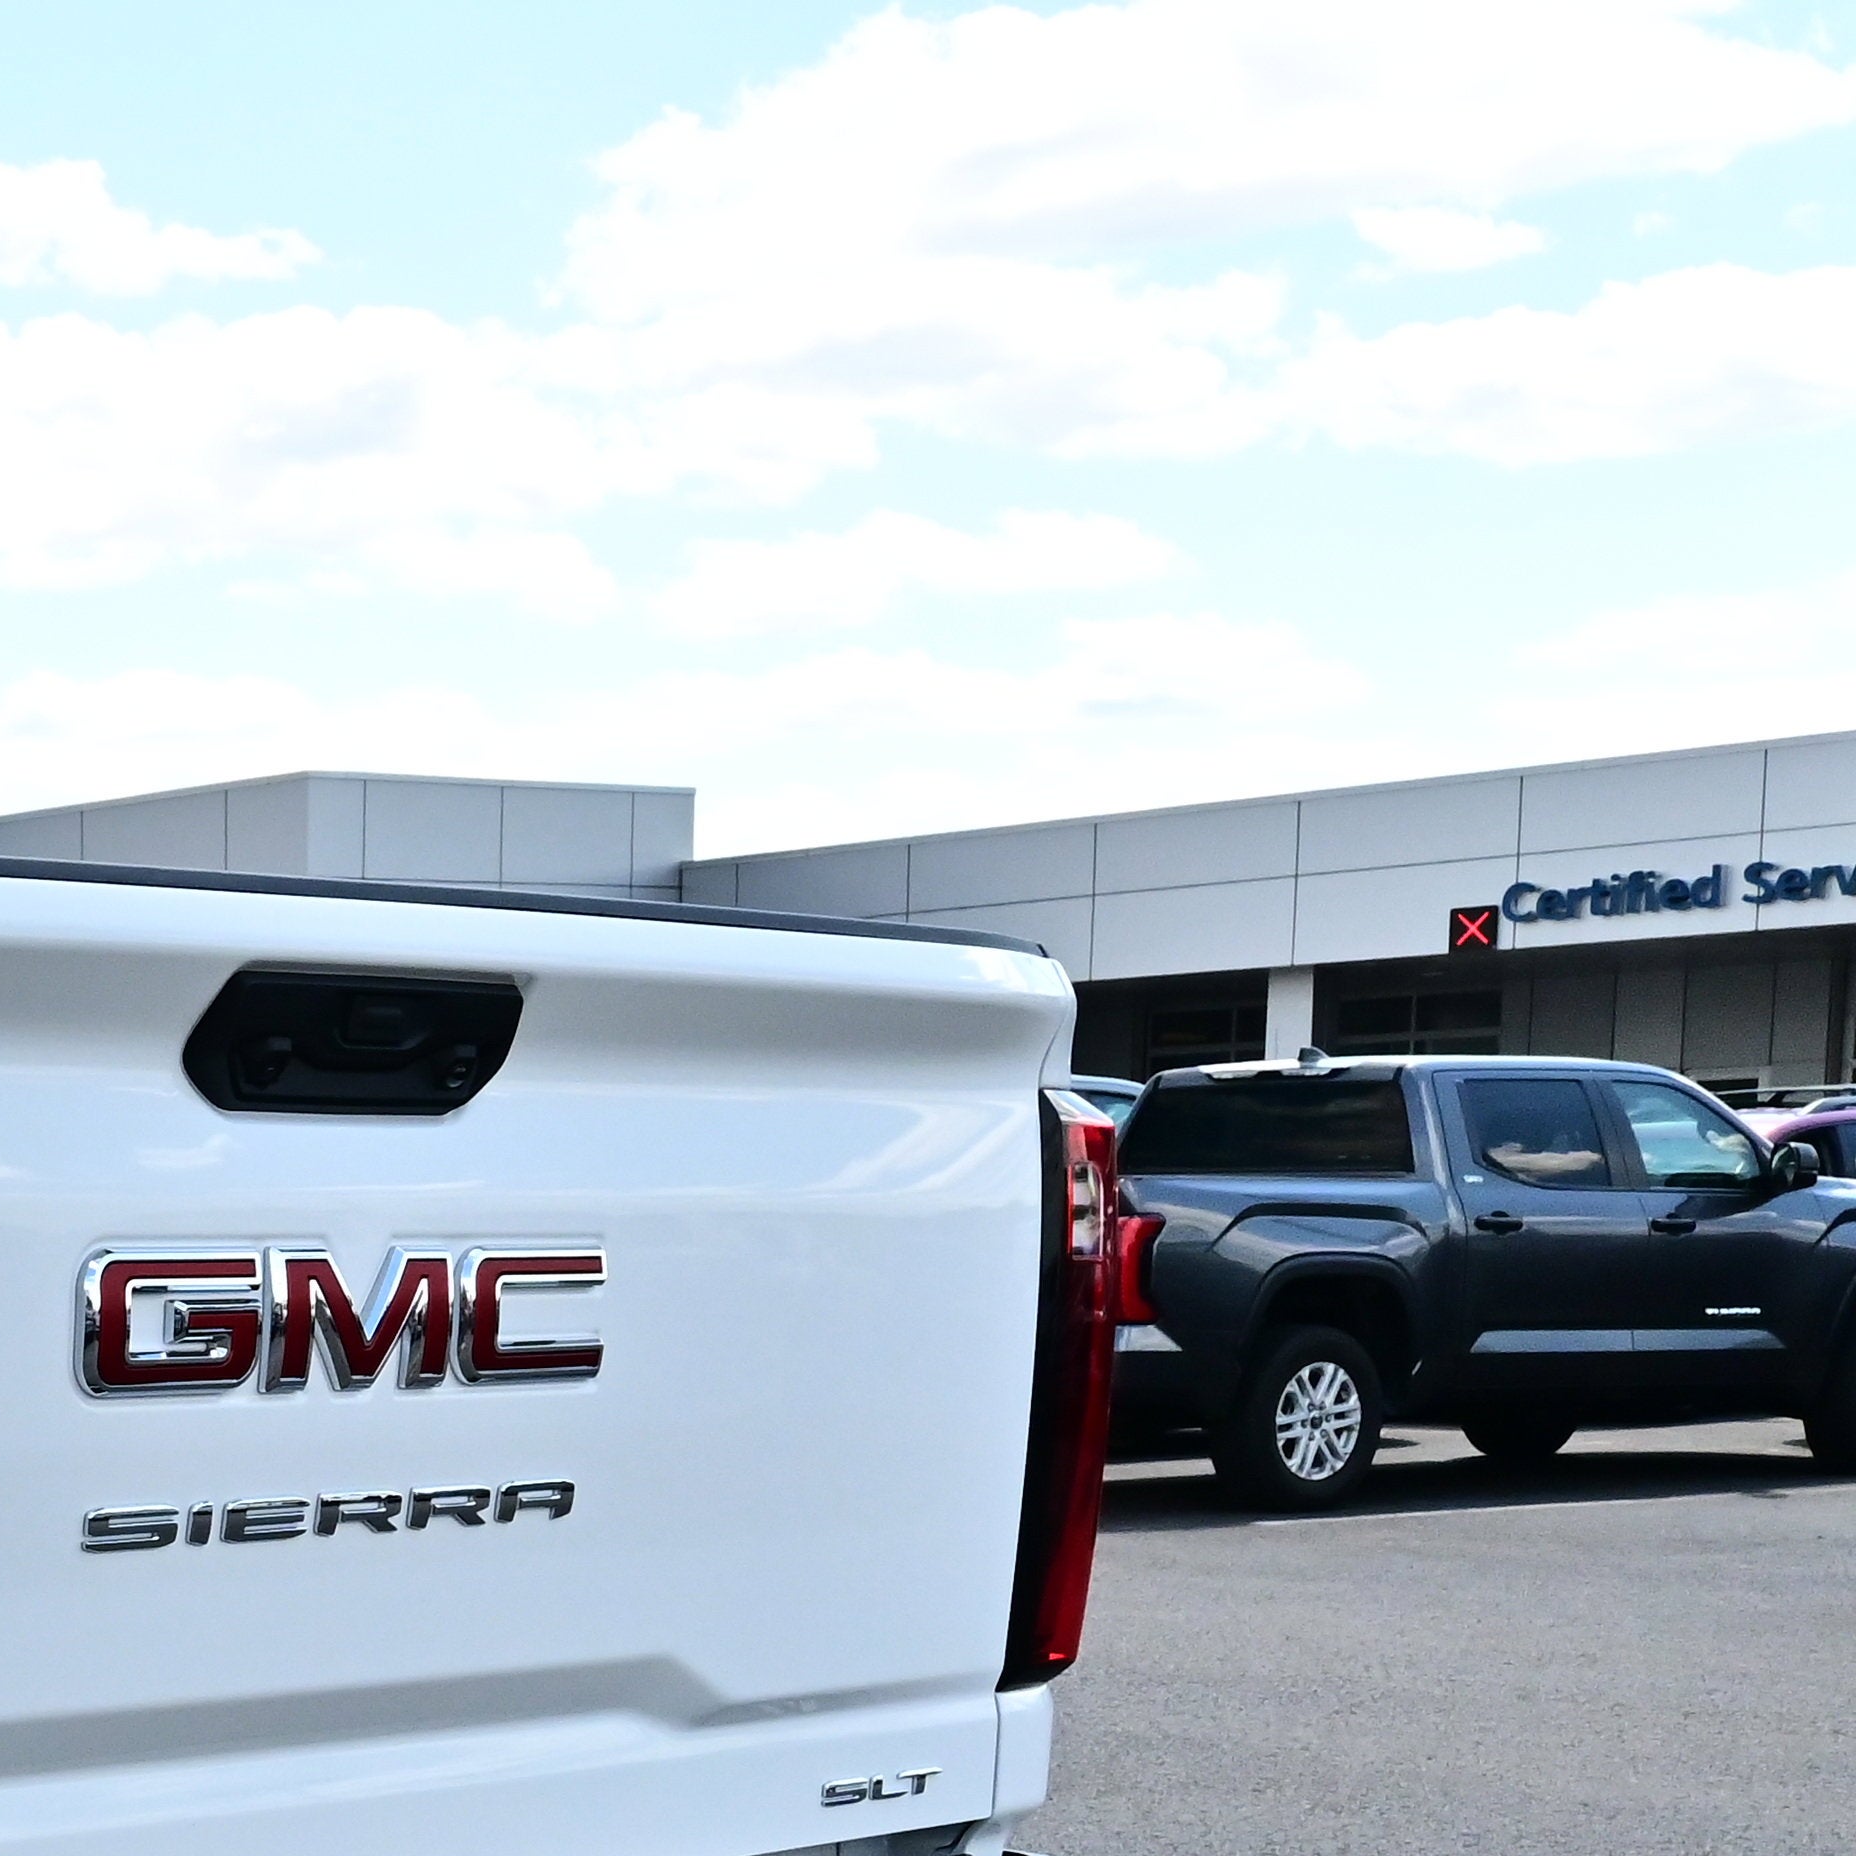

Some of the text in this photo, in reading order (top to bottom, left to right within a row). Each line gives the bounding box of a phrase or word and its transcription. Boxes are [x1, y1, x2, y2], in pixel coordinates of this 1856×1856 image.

[1502, 861, 1856, 922] Certified Serv
[74, 1245, 607, 1398] GMC
[81, 1478, 576, 1554] SIERRA
[821, 1766, 944, 1807] SLT
